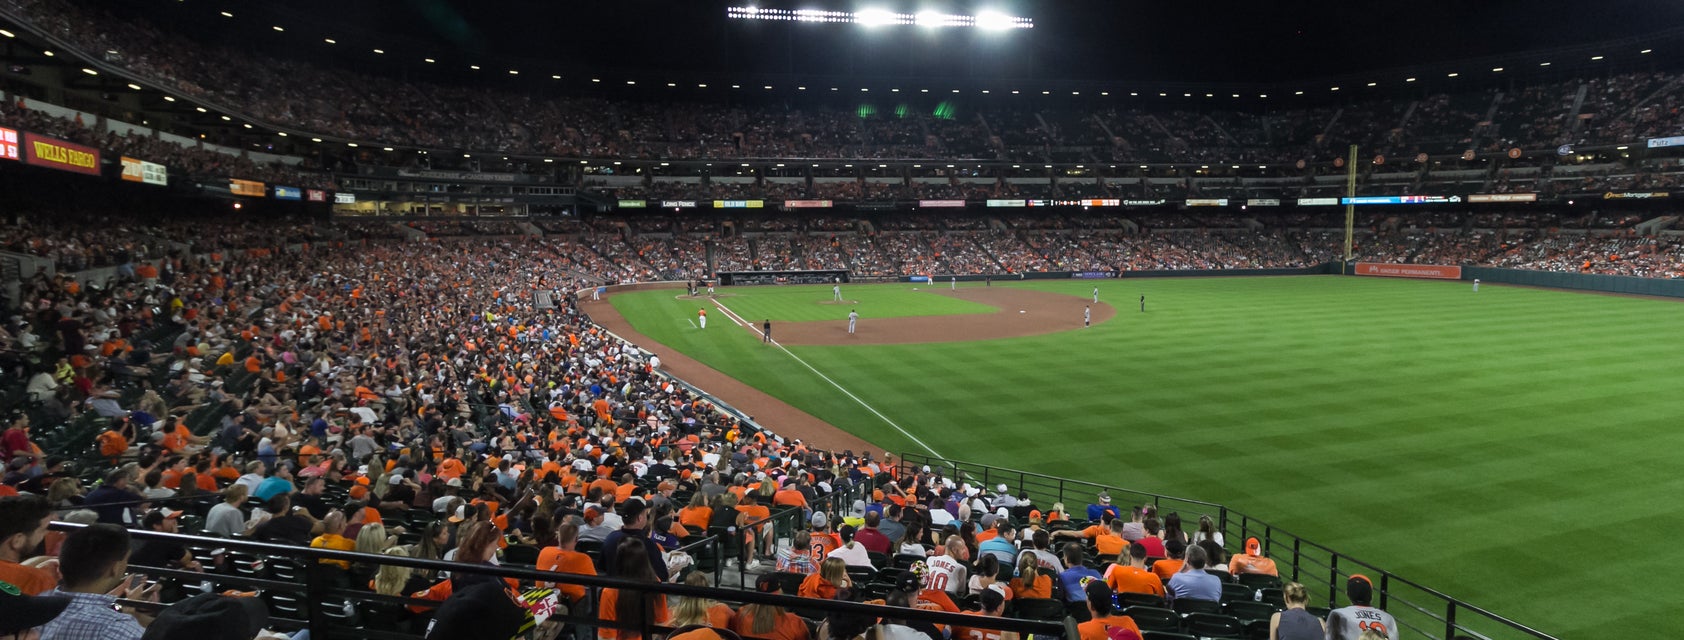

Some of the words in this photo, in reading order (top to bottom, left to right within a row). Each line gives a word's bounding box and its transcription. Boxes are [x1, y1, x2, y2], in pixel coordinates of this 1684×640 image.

[33, 141, 67, 163] WELLS
[68, 149, 95, 168] FARGO
[931, 560, 956, 573] JONES
[927, 570, 949, 591] 10
[1354, 610, 1382, 621] JONES
